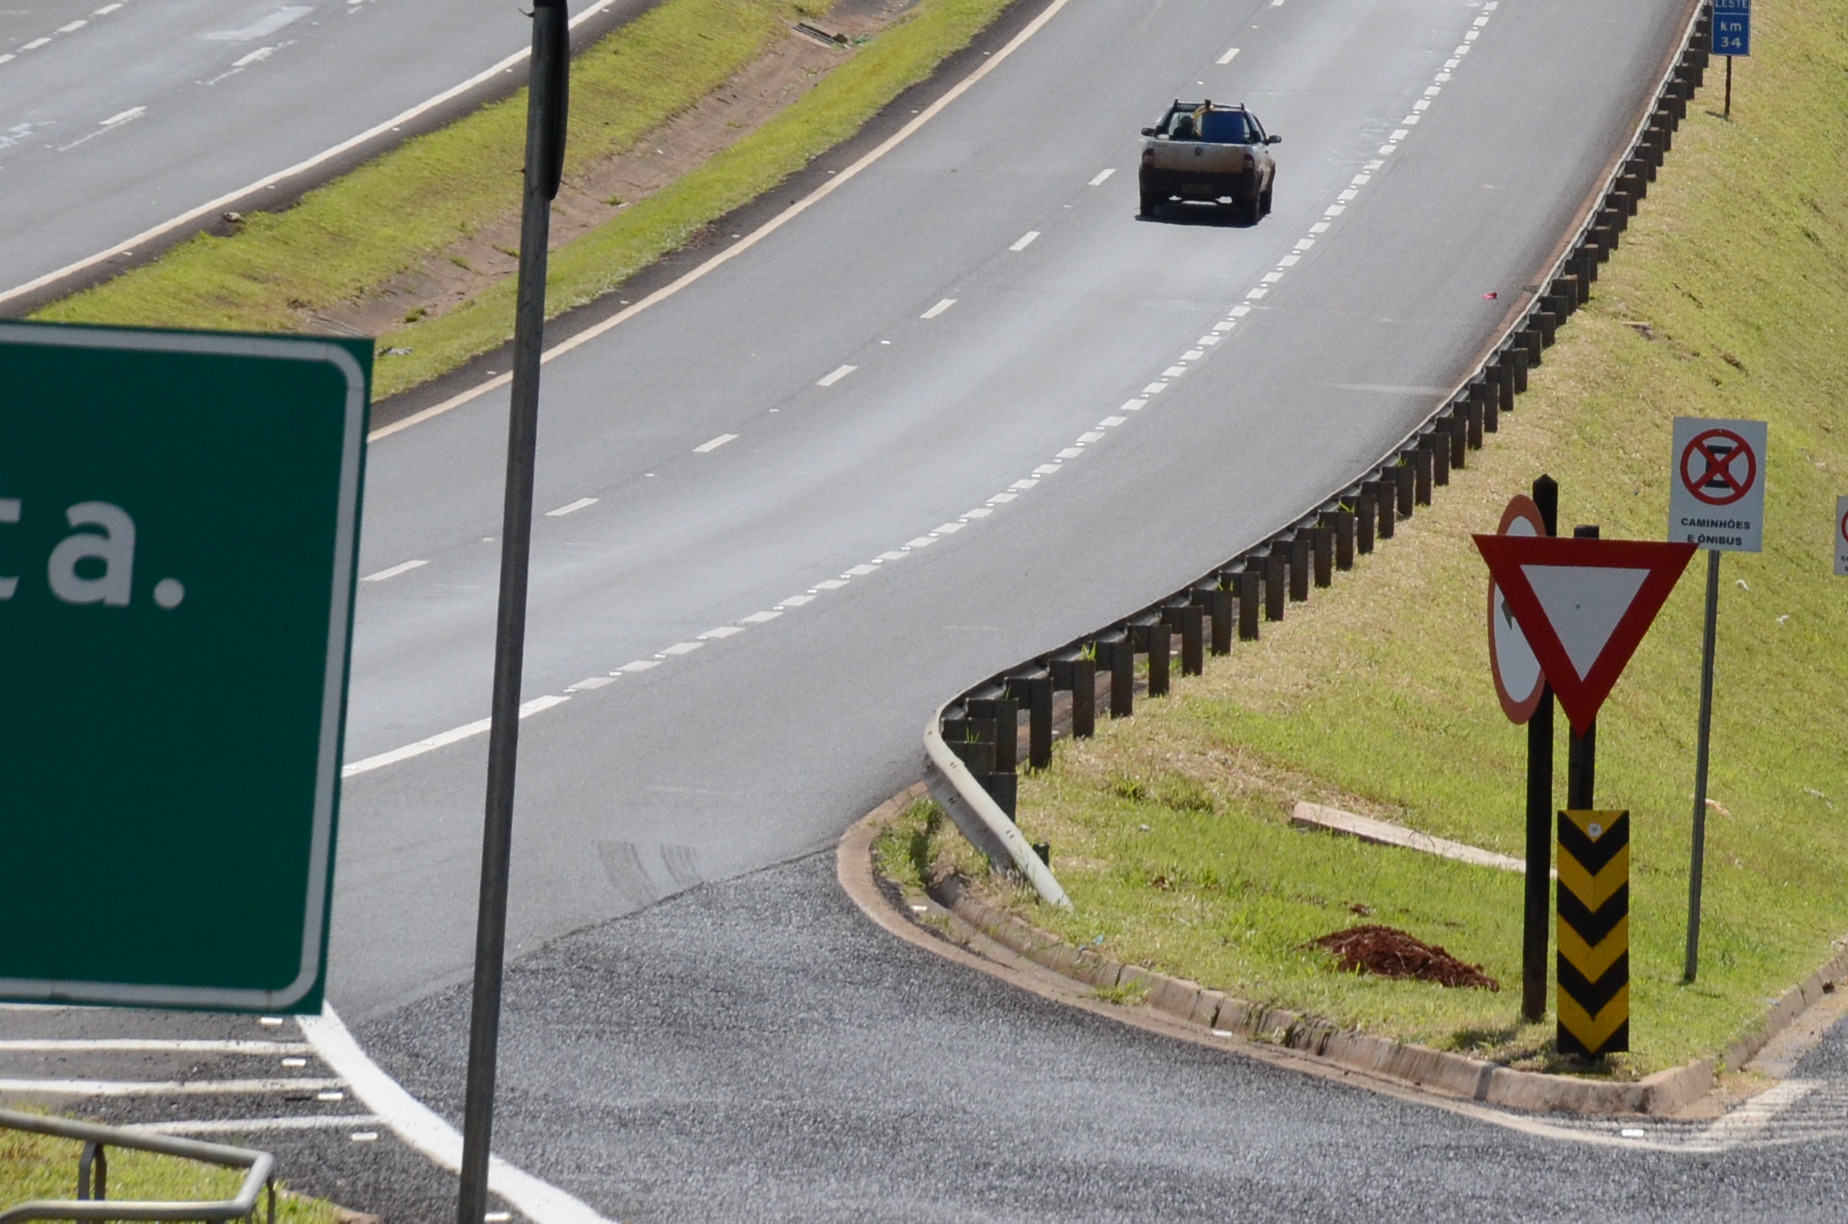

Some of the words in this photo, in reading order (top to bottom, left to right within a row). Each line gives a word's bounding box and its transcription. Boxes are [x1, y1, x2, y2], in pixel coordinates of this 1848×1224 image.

[1720, 20, 1742, 32] km
[1720, 36, 1742, 48] 34
[1680, 517, 1751, 530] CAMINHÕES
[1687, 534, 1695, 543] E
[1697, 533, 1743, 546] ÔNIBUS
[0, 497, 186, 610] a.
